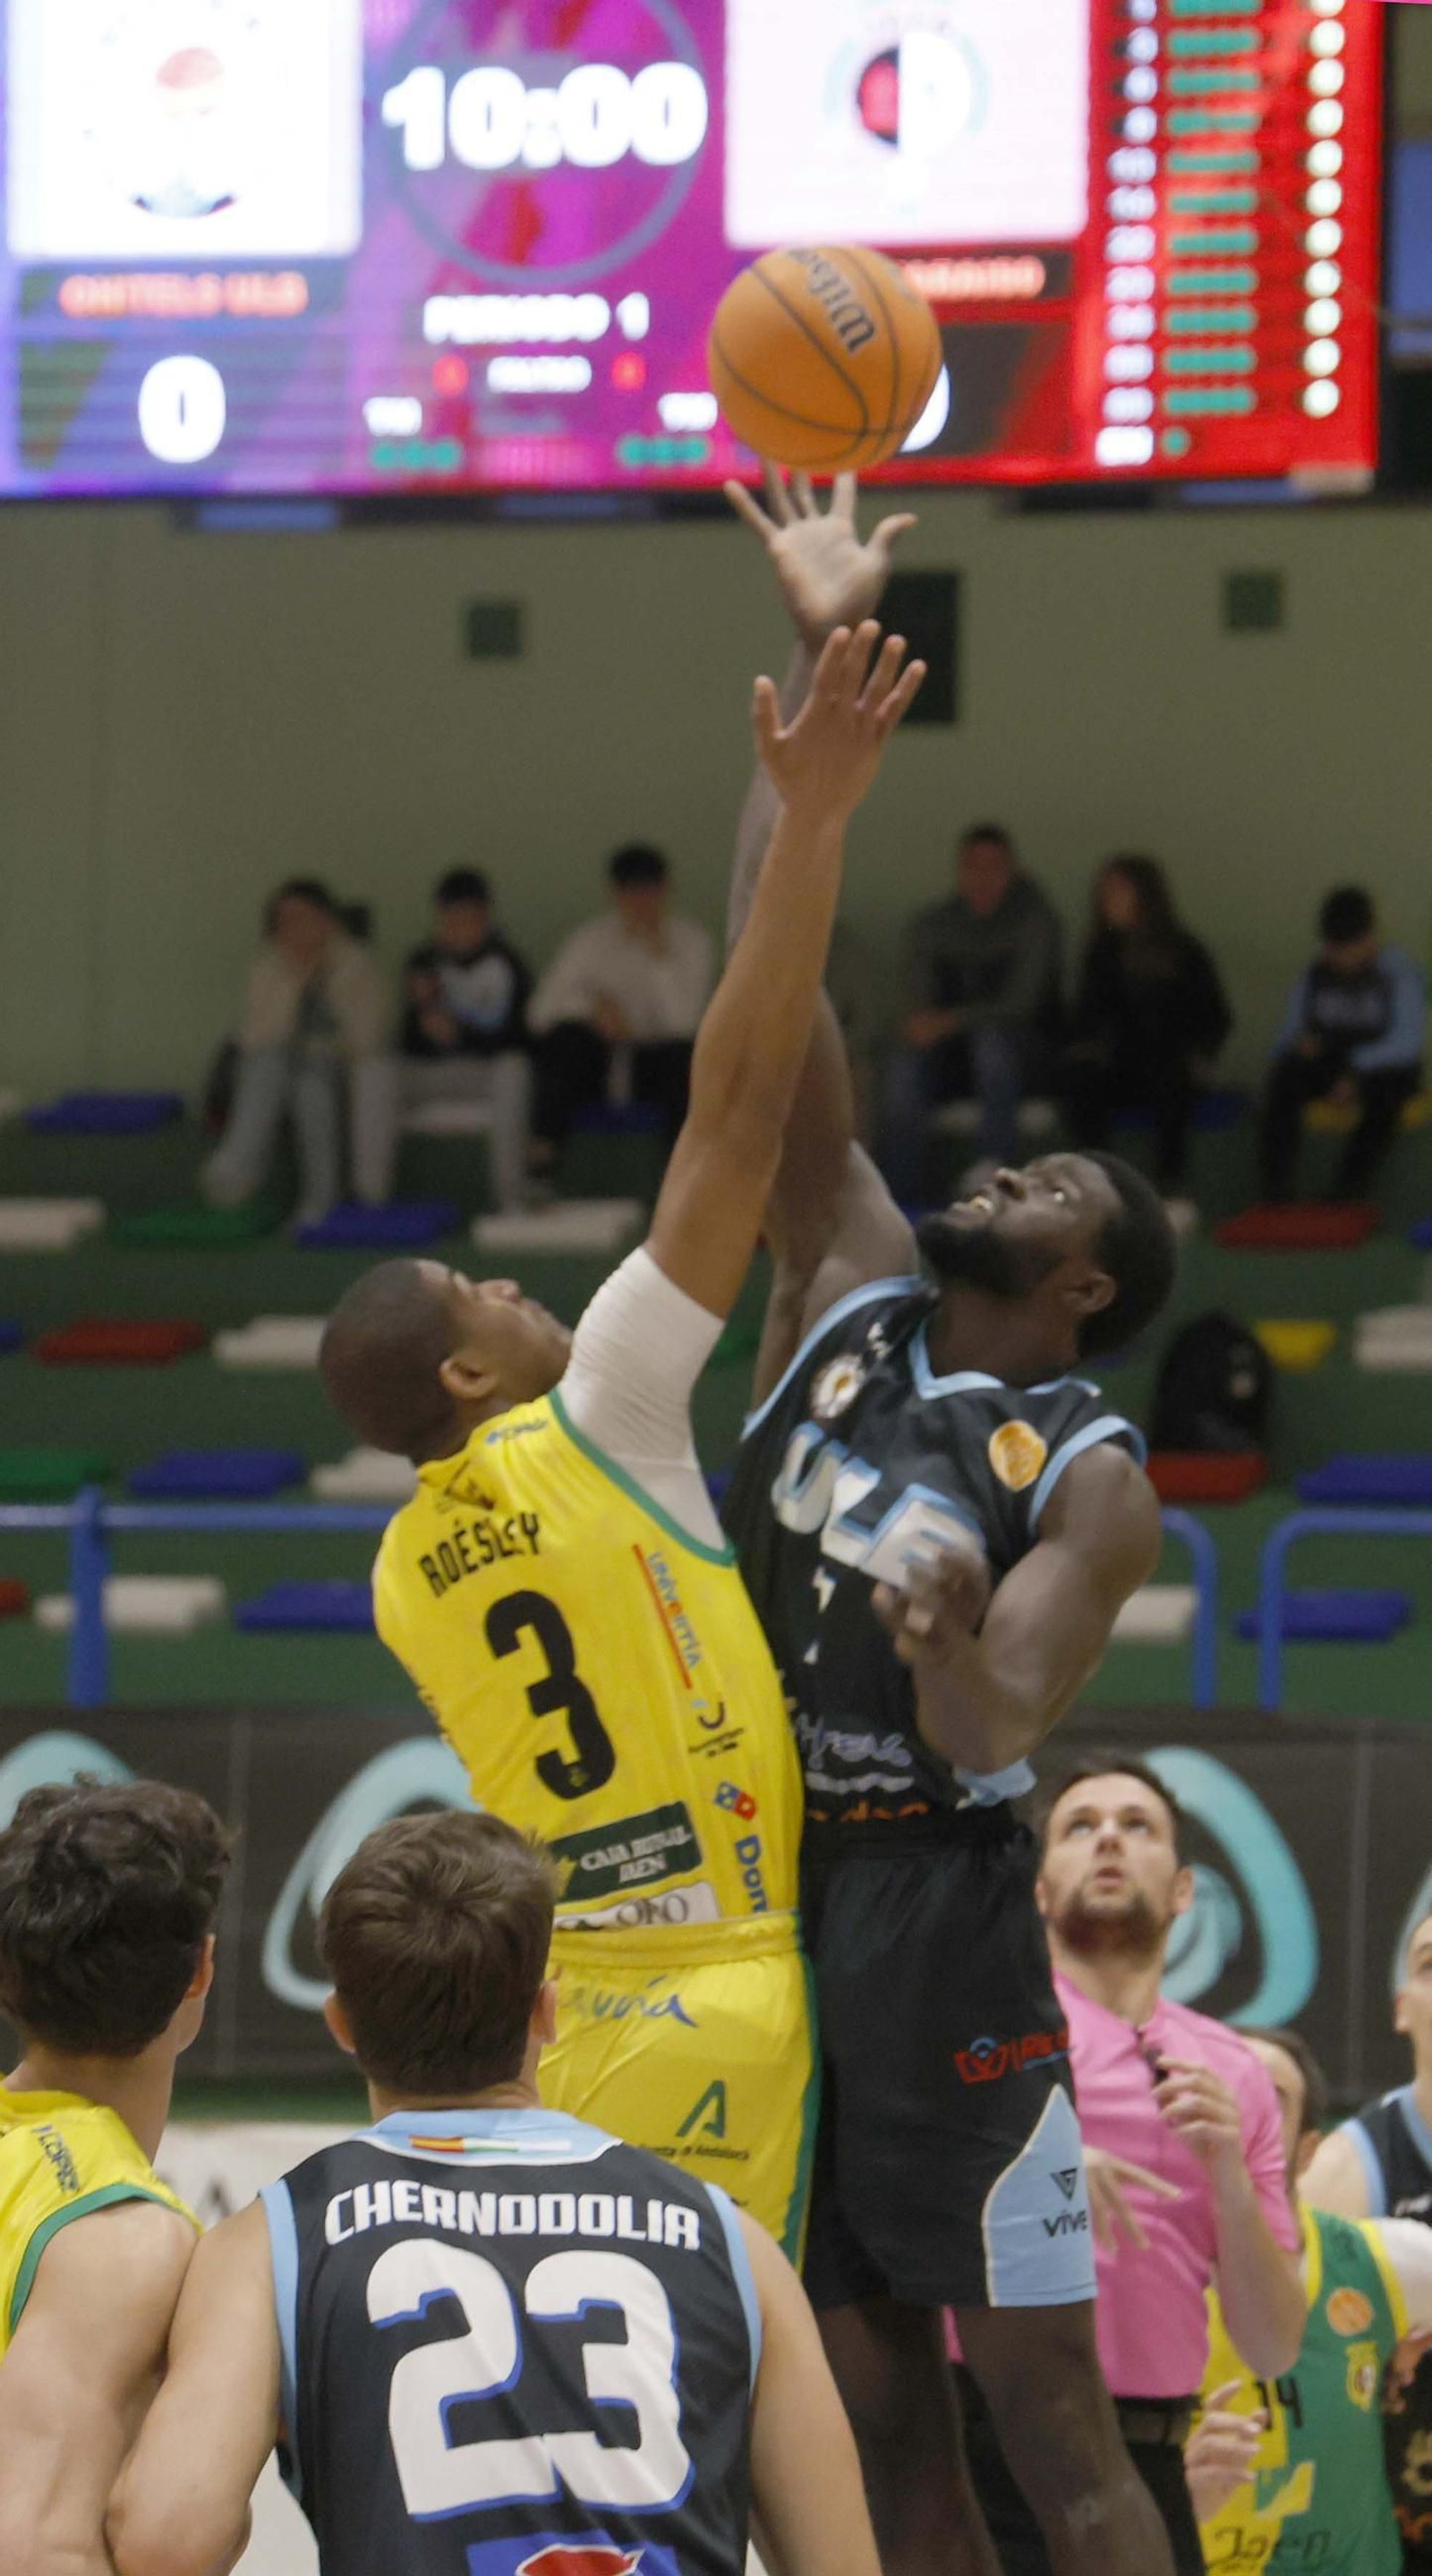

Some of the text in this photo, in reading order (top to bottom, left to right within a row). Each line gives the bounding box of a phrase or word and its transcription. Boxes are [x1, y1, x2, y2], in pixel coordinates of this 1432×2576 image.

[382, 62, 708, 170] 10:00
[139, 354, 226, 463] 0
[484, 1589, 616, 1801] 3
[324, 2179, 701, 2251] CHERNODOLIA
[365, 2237, 696, 2523] 23
